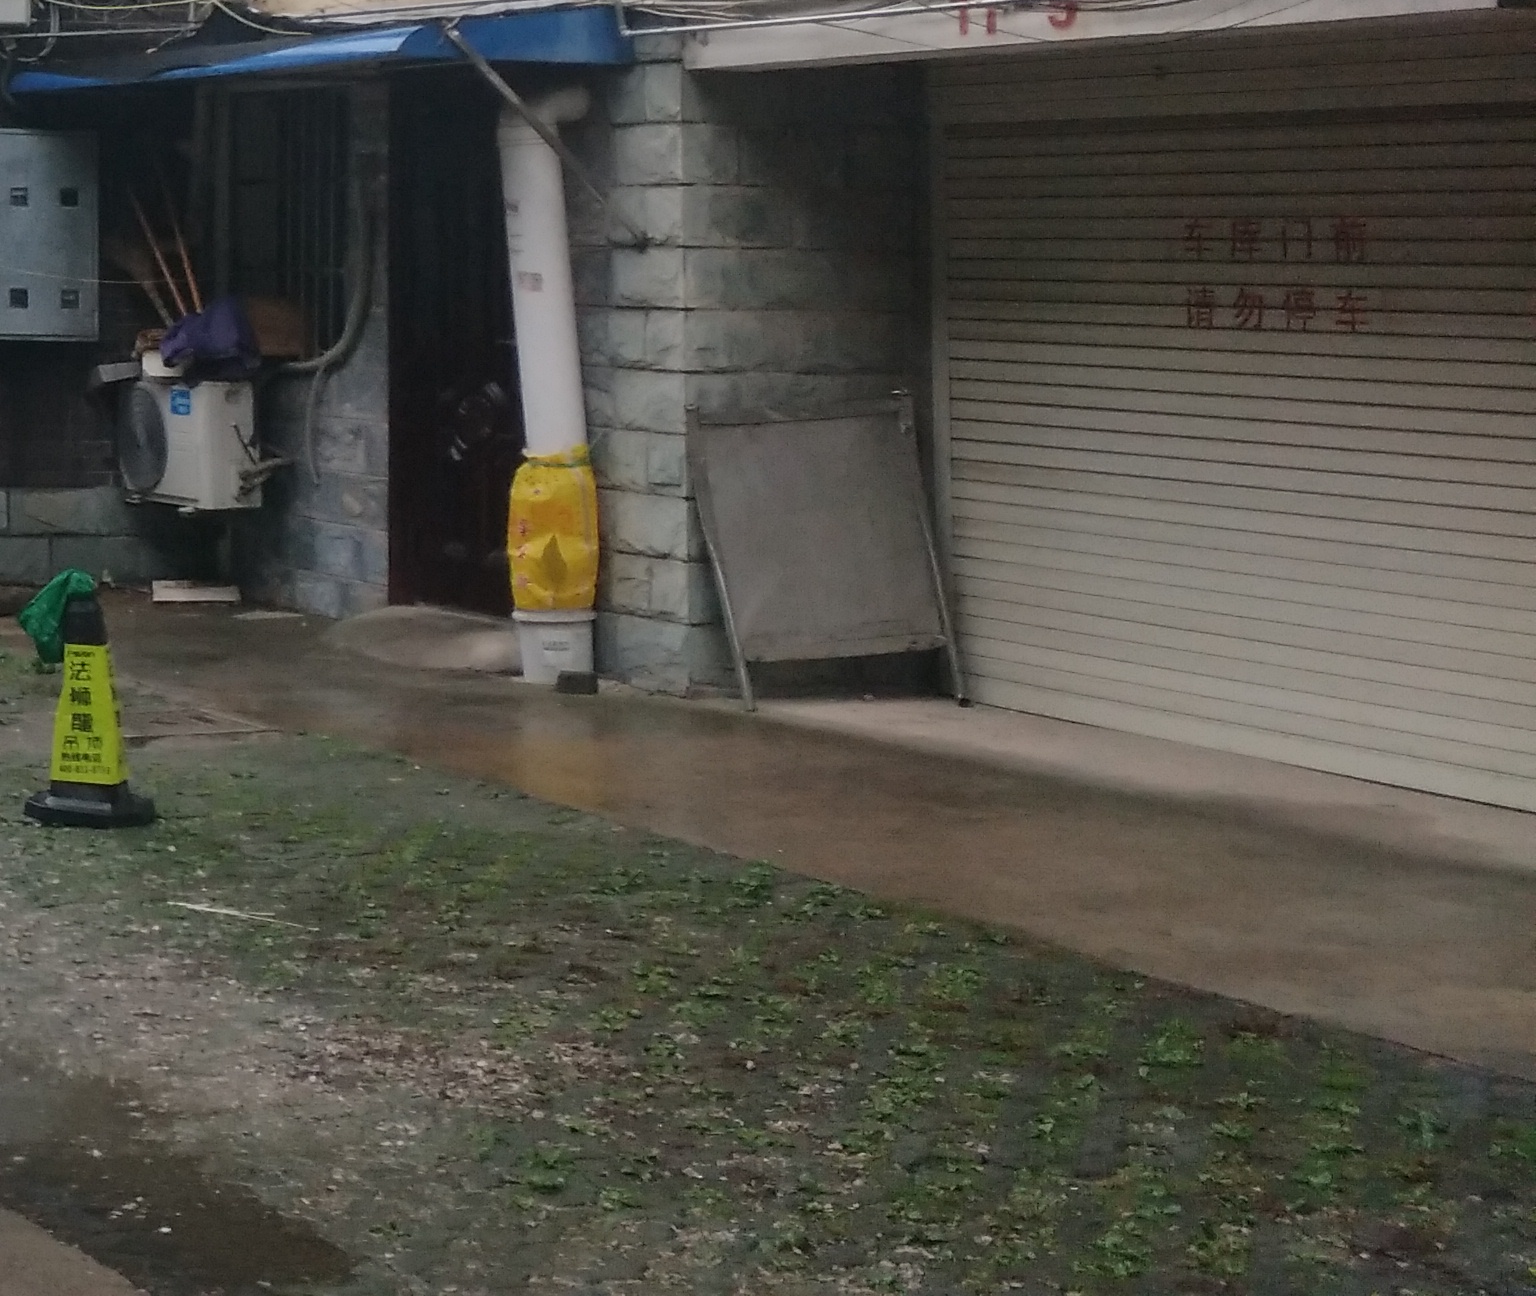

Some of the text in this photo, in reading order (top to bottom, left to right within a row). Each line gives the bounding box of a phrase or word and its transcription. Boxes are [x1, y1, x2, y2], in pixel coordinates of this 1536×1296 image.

[1181, 215, 1368, 262] 车库门前
[1184, 286, 1371, 333] 请勿停车
